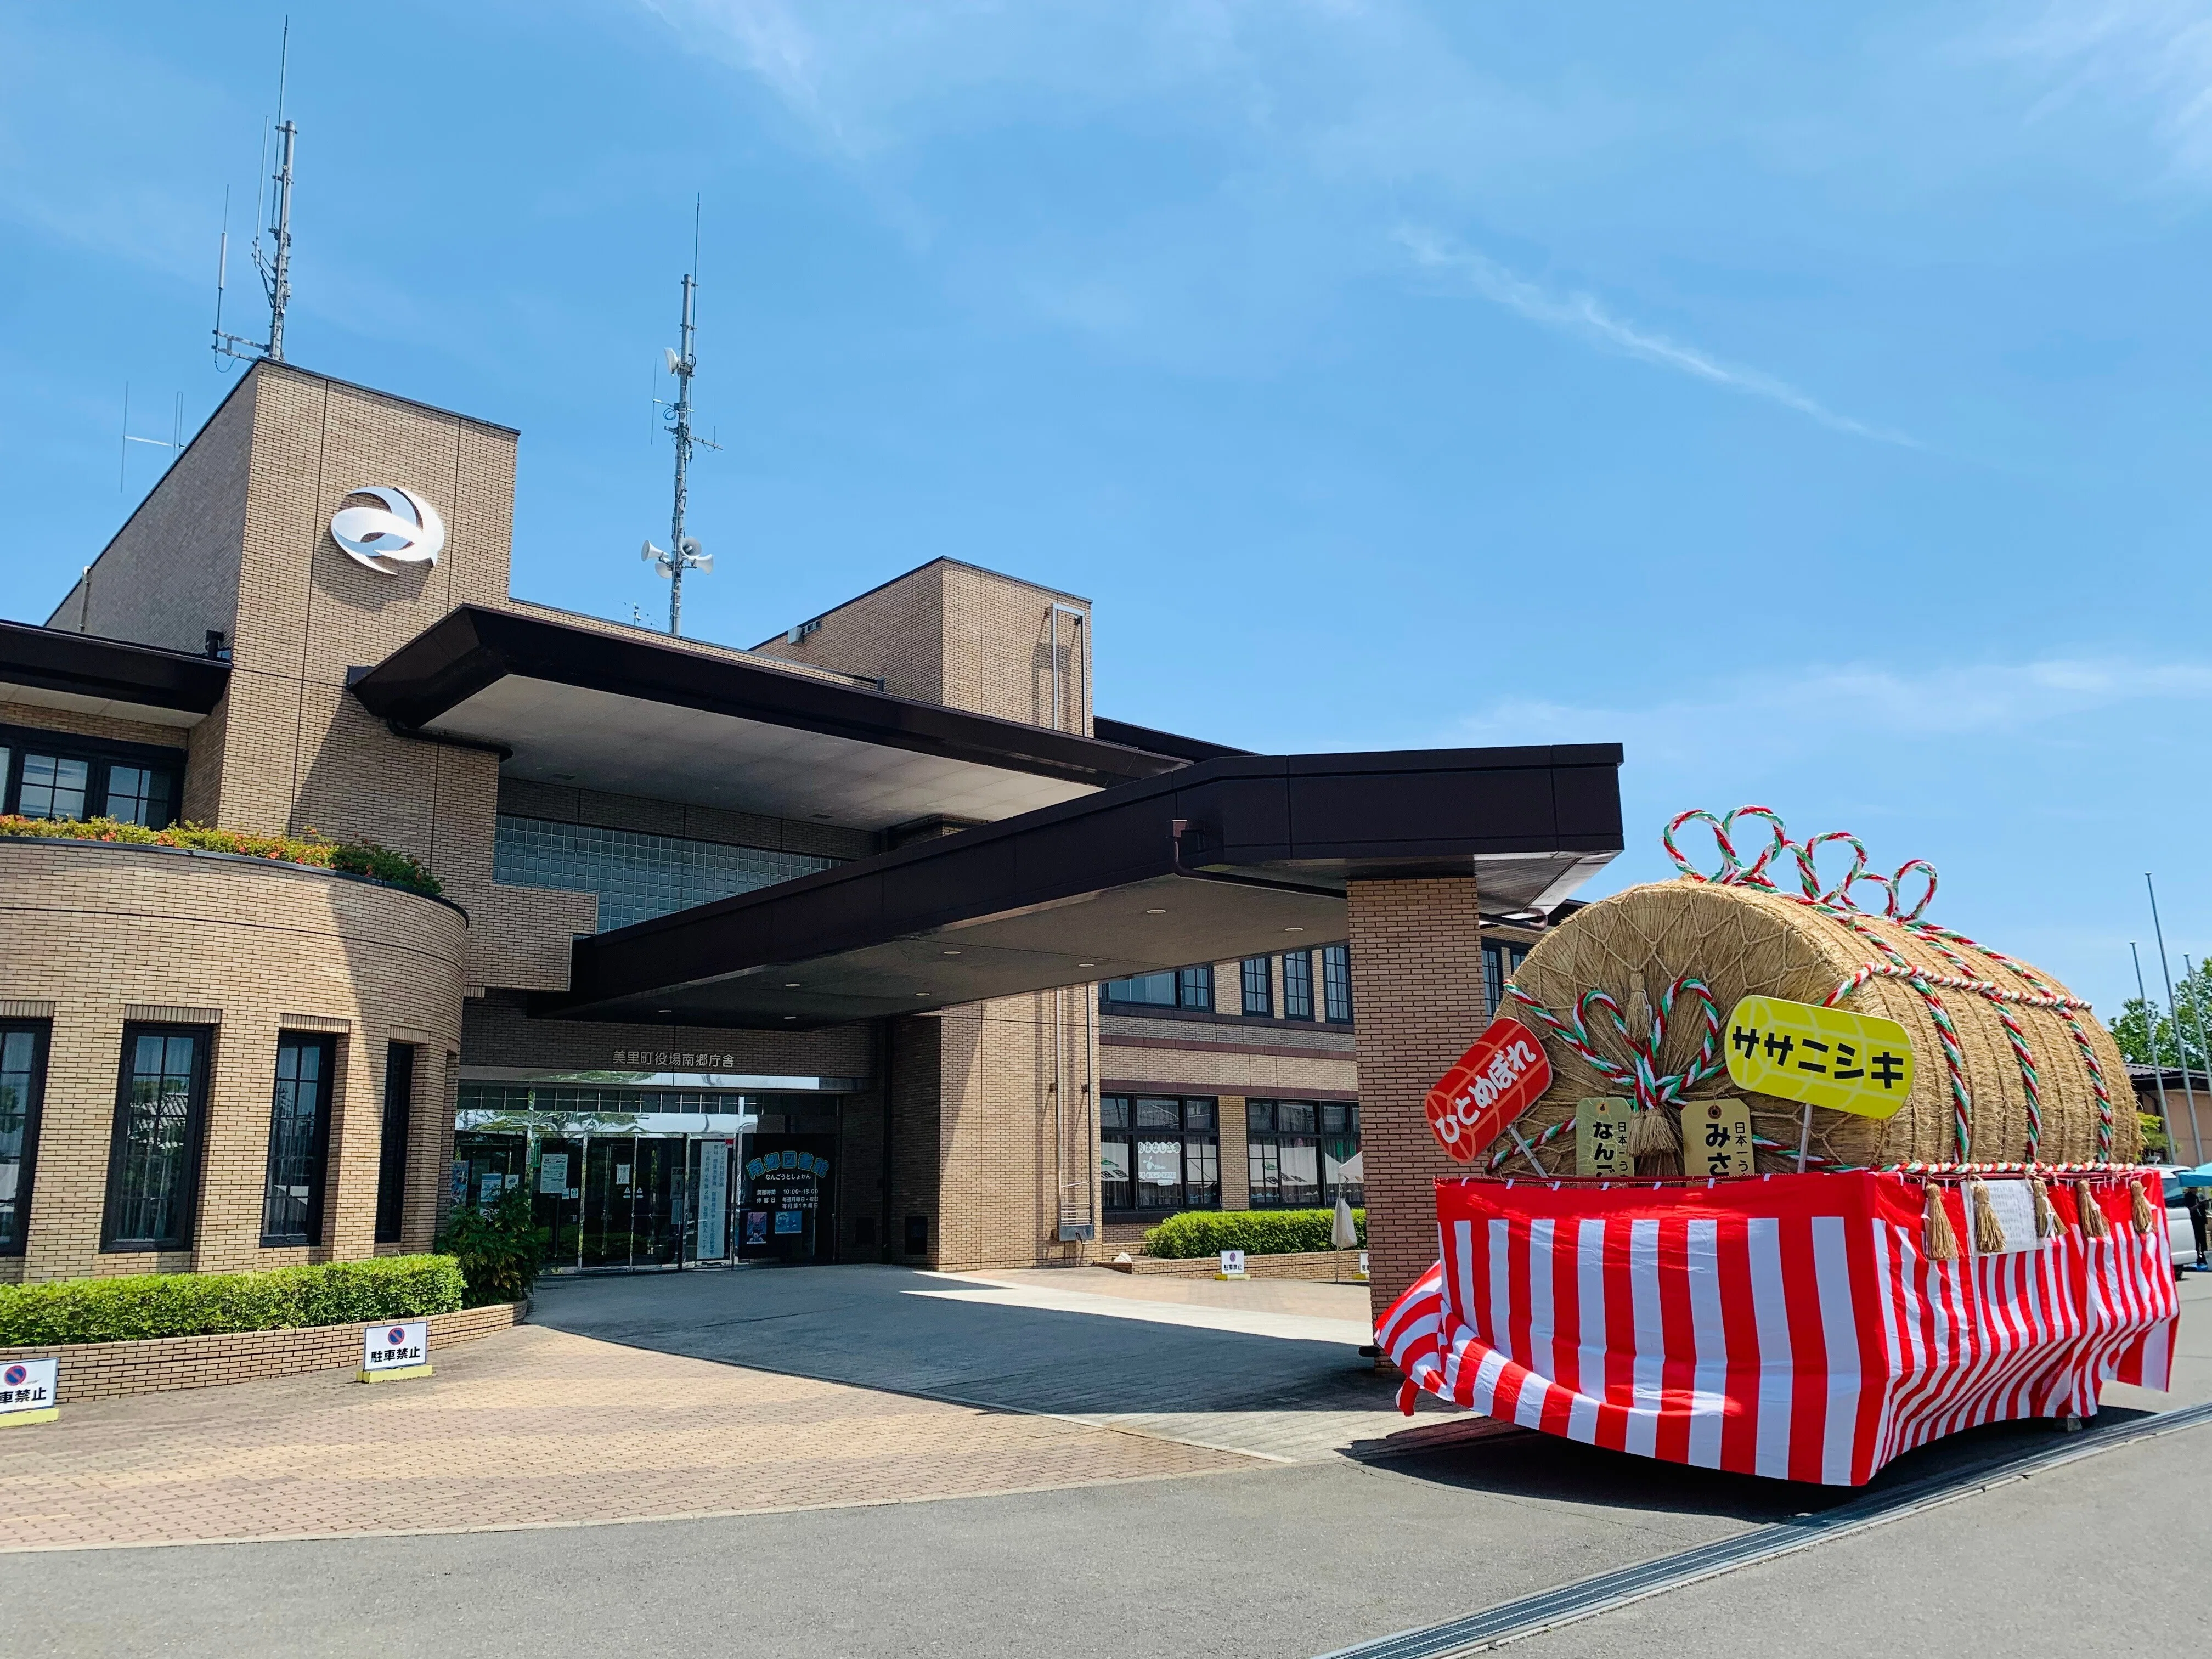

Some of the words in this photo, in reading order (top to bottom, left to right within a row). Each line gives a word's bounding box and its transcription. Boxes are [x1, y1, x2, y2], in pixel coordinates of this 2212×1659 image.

[612, 1050, 735, 1068] 美里町役場南郷庁舎
[1733, 1026, 1903, 1089] ササニシキ
[1435, 1040, 1536, 1143] ひとめぼれ
[1138, 1143, 1180, 1152] おはなし広場
[746, 1150, 830, 1180] 南郷図書館
[370, 1346, 420, 1363] 駐車禁止
[0, 1387, 46, 1404] 車禁止
